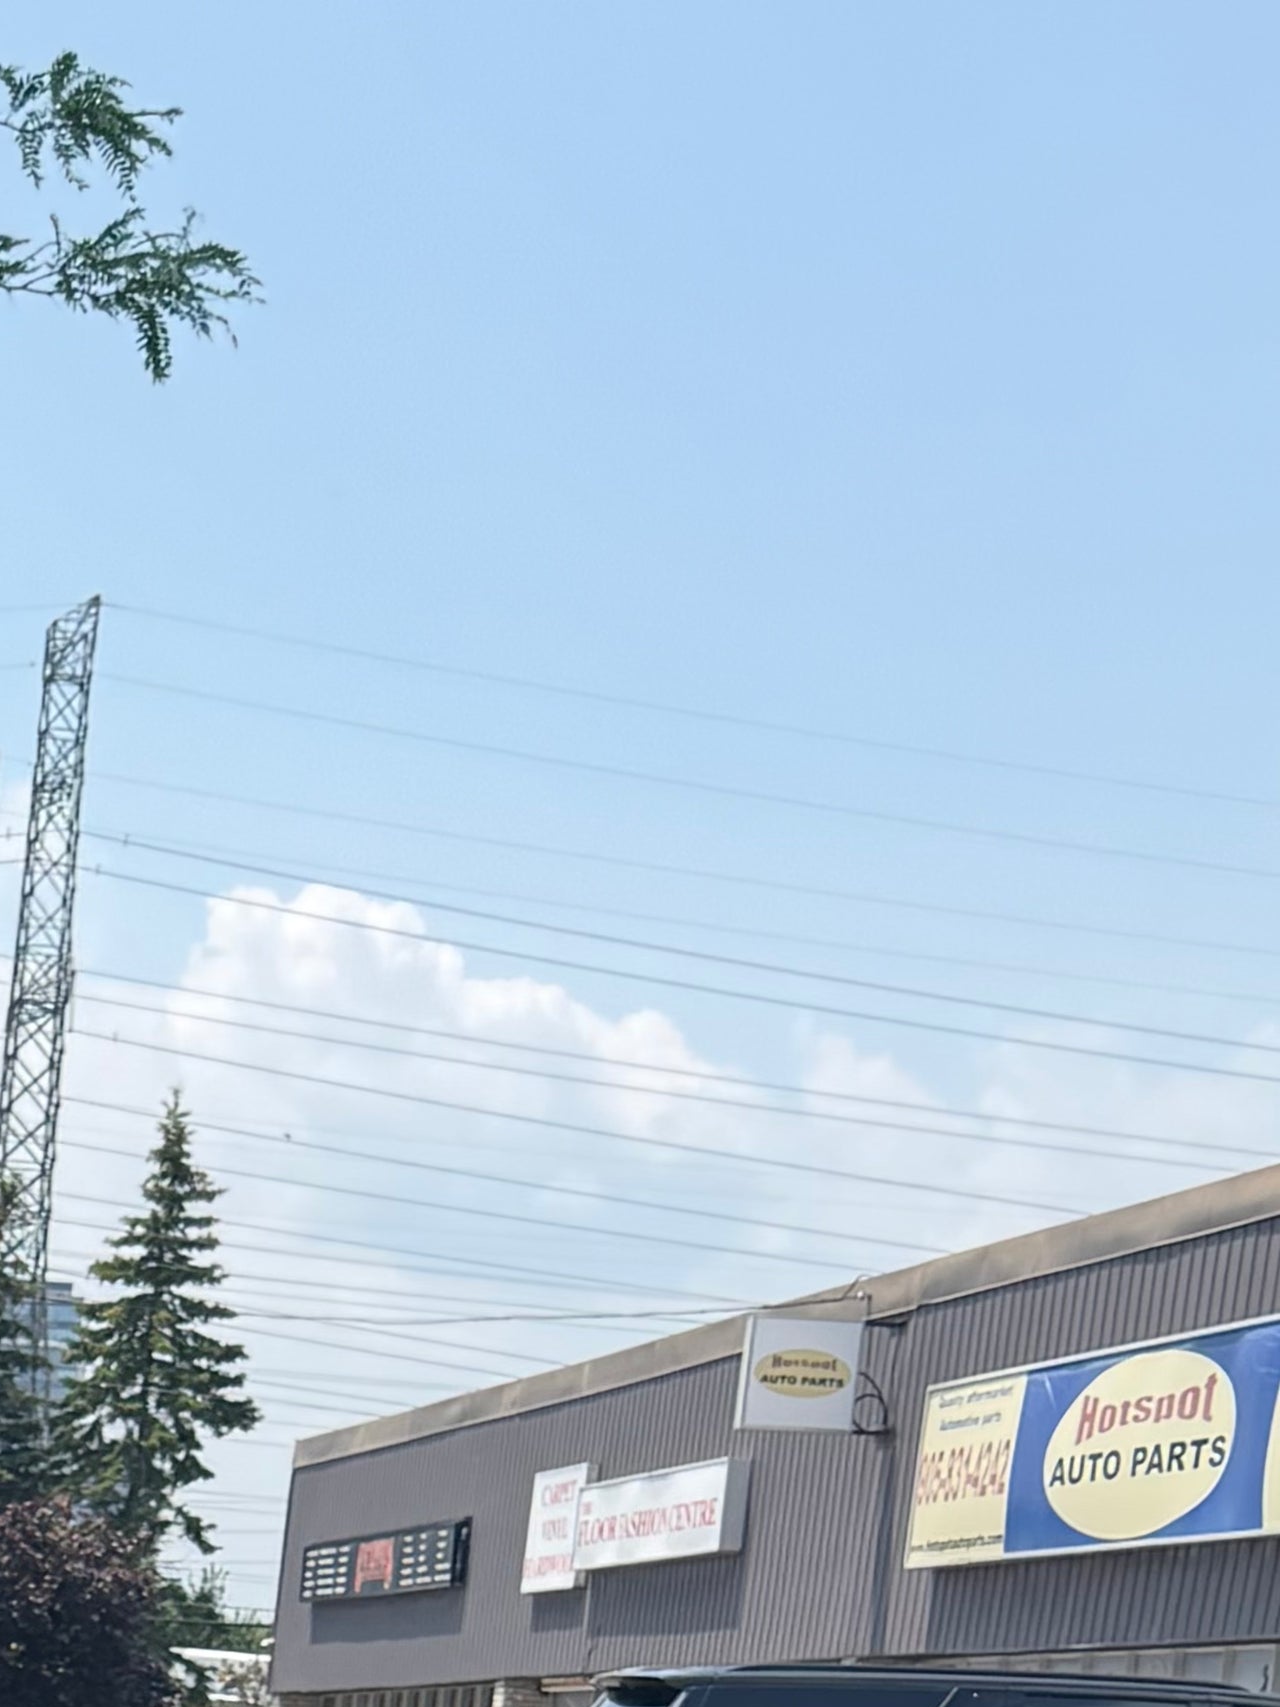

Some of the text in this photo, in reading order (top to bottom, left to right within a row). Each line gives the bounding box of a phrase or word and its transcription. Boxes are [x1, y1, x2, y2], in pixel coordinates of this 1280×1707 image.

[760, 1374, 844, 1388] AUTO PARTS
[1075, 1373, 1218, 1446] Hotspot
[1049, 1435, 1226, 1487] AUTO PARTS
[577, 1498, 718, 1548] FLOOR FASHION CENTRE
